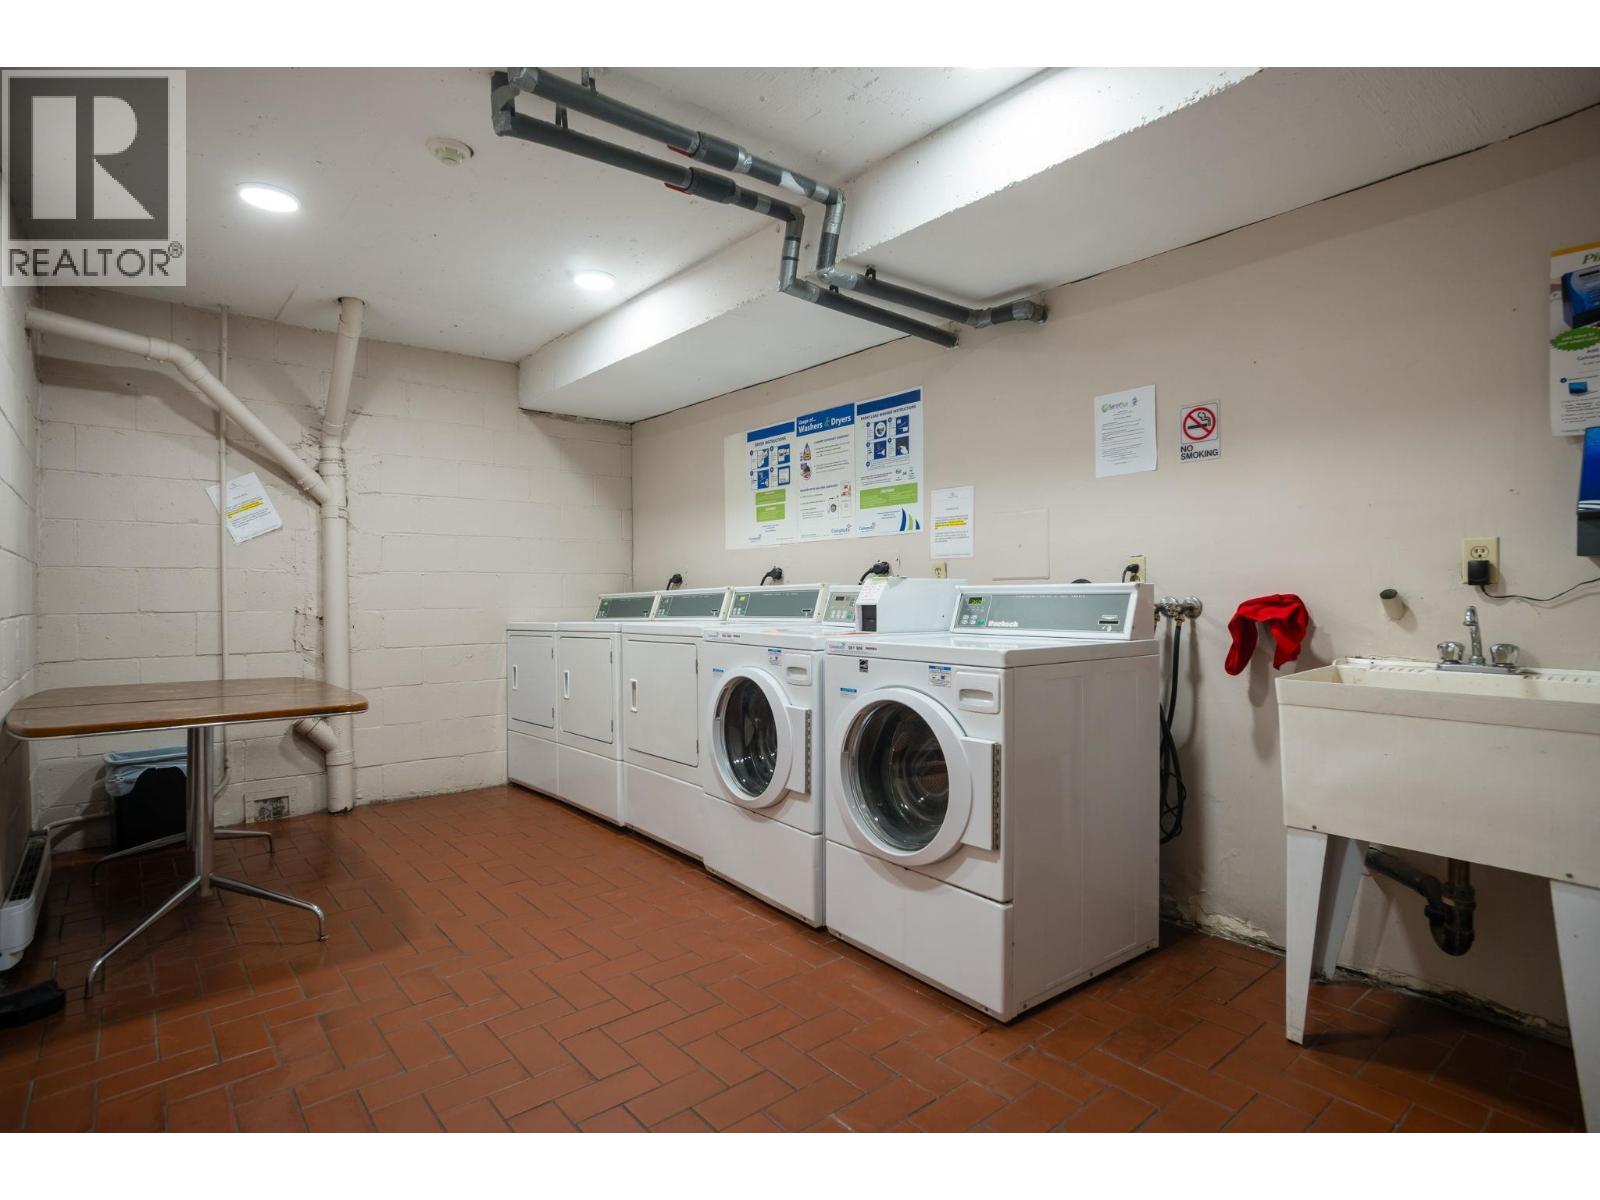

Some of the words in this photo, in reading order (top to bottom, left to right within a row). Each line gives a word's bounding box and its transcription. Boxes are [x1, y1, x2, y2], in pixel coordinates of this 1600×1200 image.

[798, 422, 823, 433] Washers
[830, 415, 852, 426] Dryers
[1180, 444, 1194, 453] NO
[1180, 448, 1219, 461] SMOKING
